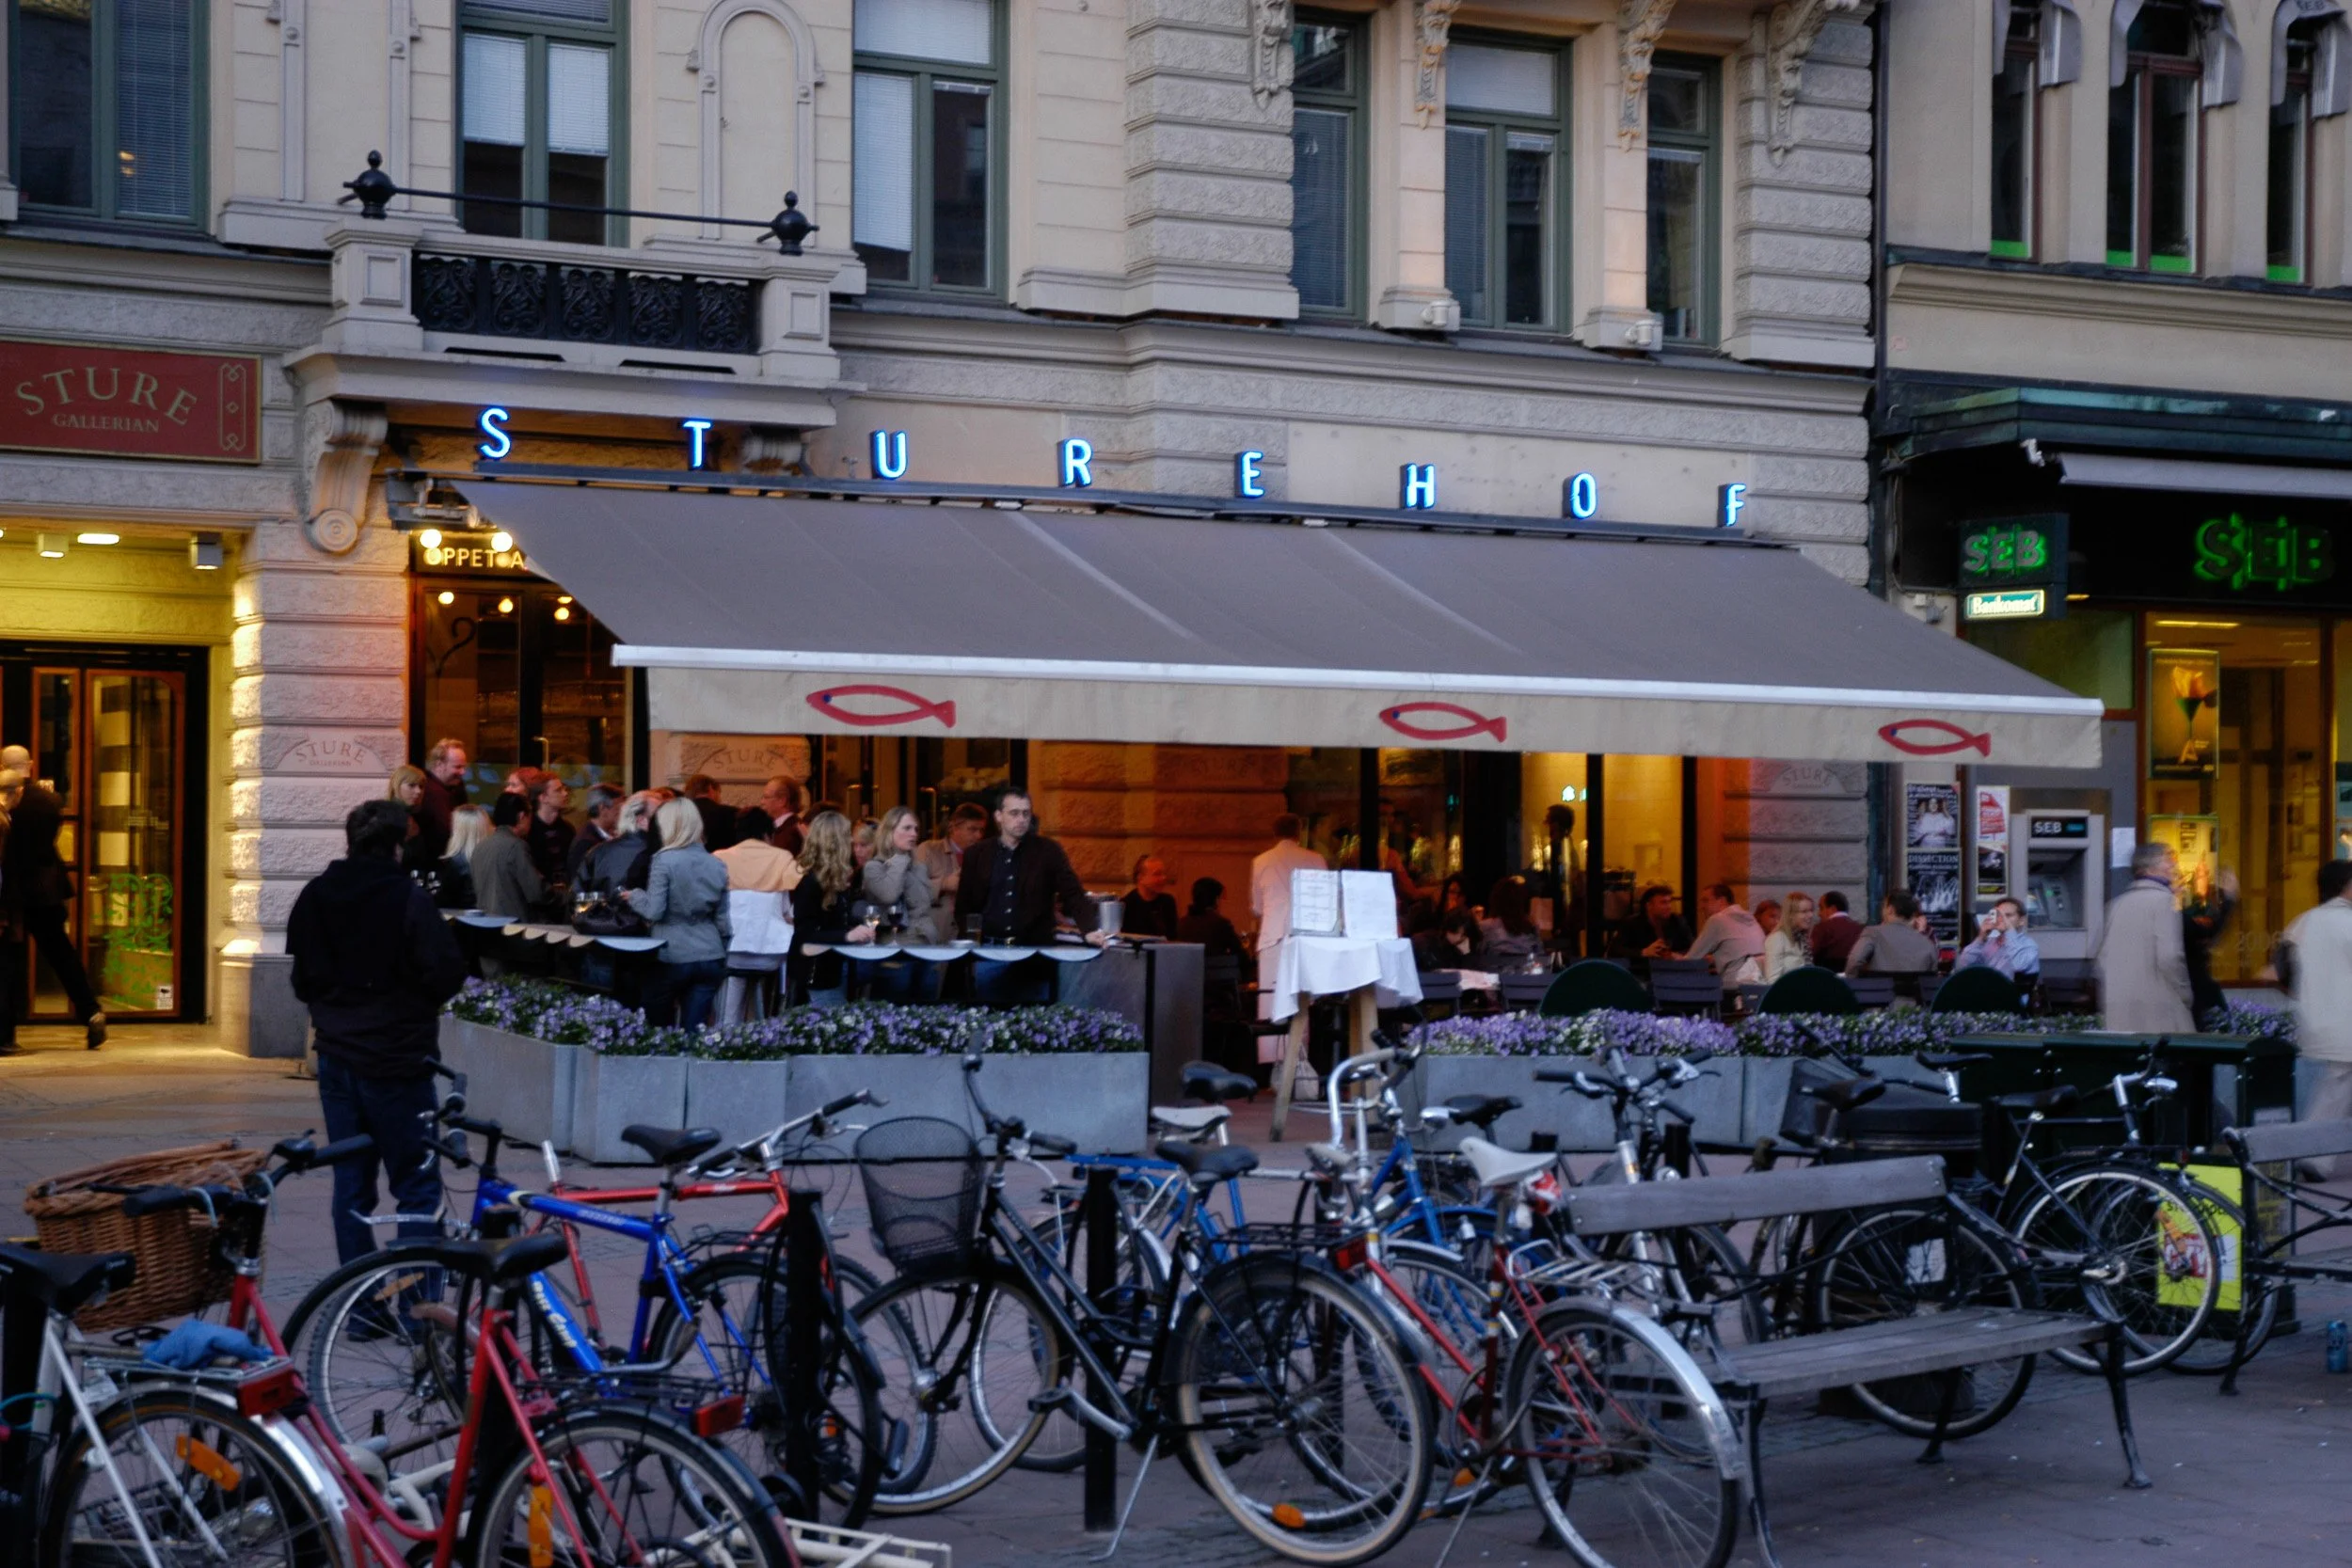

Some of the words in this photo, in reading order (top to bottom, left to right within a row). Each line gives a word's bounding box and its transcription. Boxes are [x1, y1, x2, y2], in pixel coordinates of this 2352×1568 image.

[15, 367, 198, 425] STURE
[53, 413, 159, 434] GALLERIAN
[1963, 528, 2045, 573] SEB
[2194, 514, 2336, 589] SEB
[1972, 594, 2038, 615] Bankomat
[296, 740, 366, 765] STURE
[713, 749, 775, 769] STURE
[2033, 821, 2062, 833] SEB
[1908, 854, 1958, 863] DISSECTION
